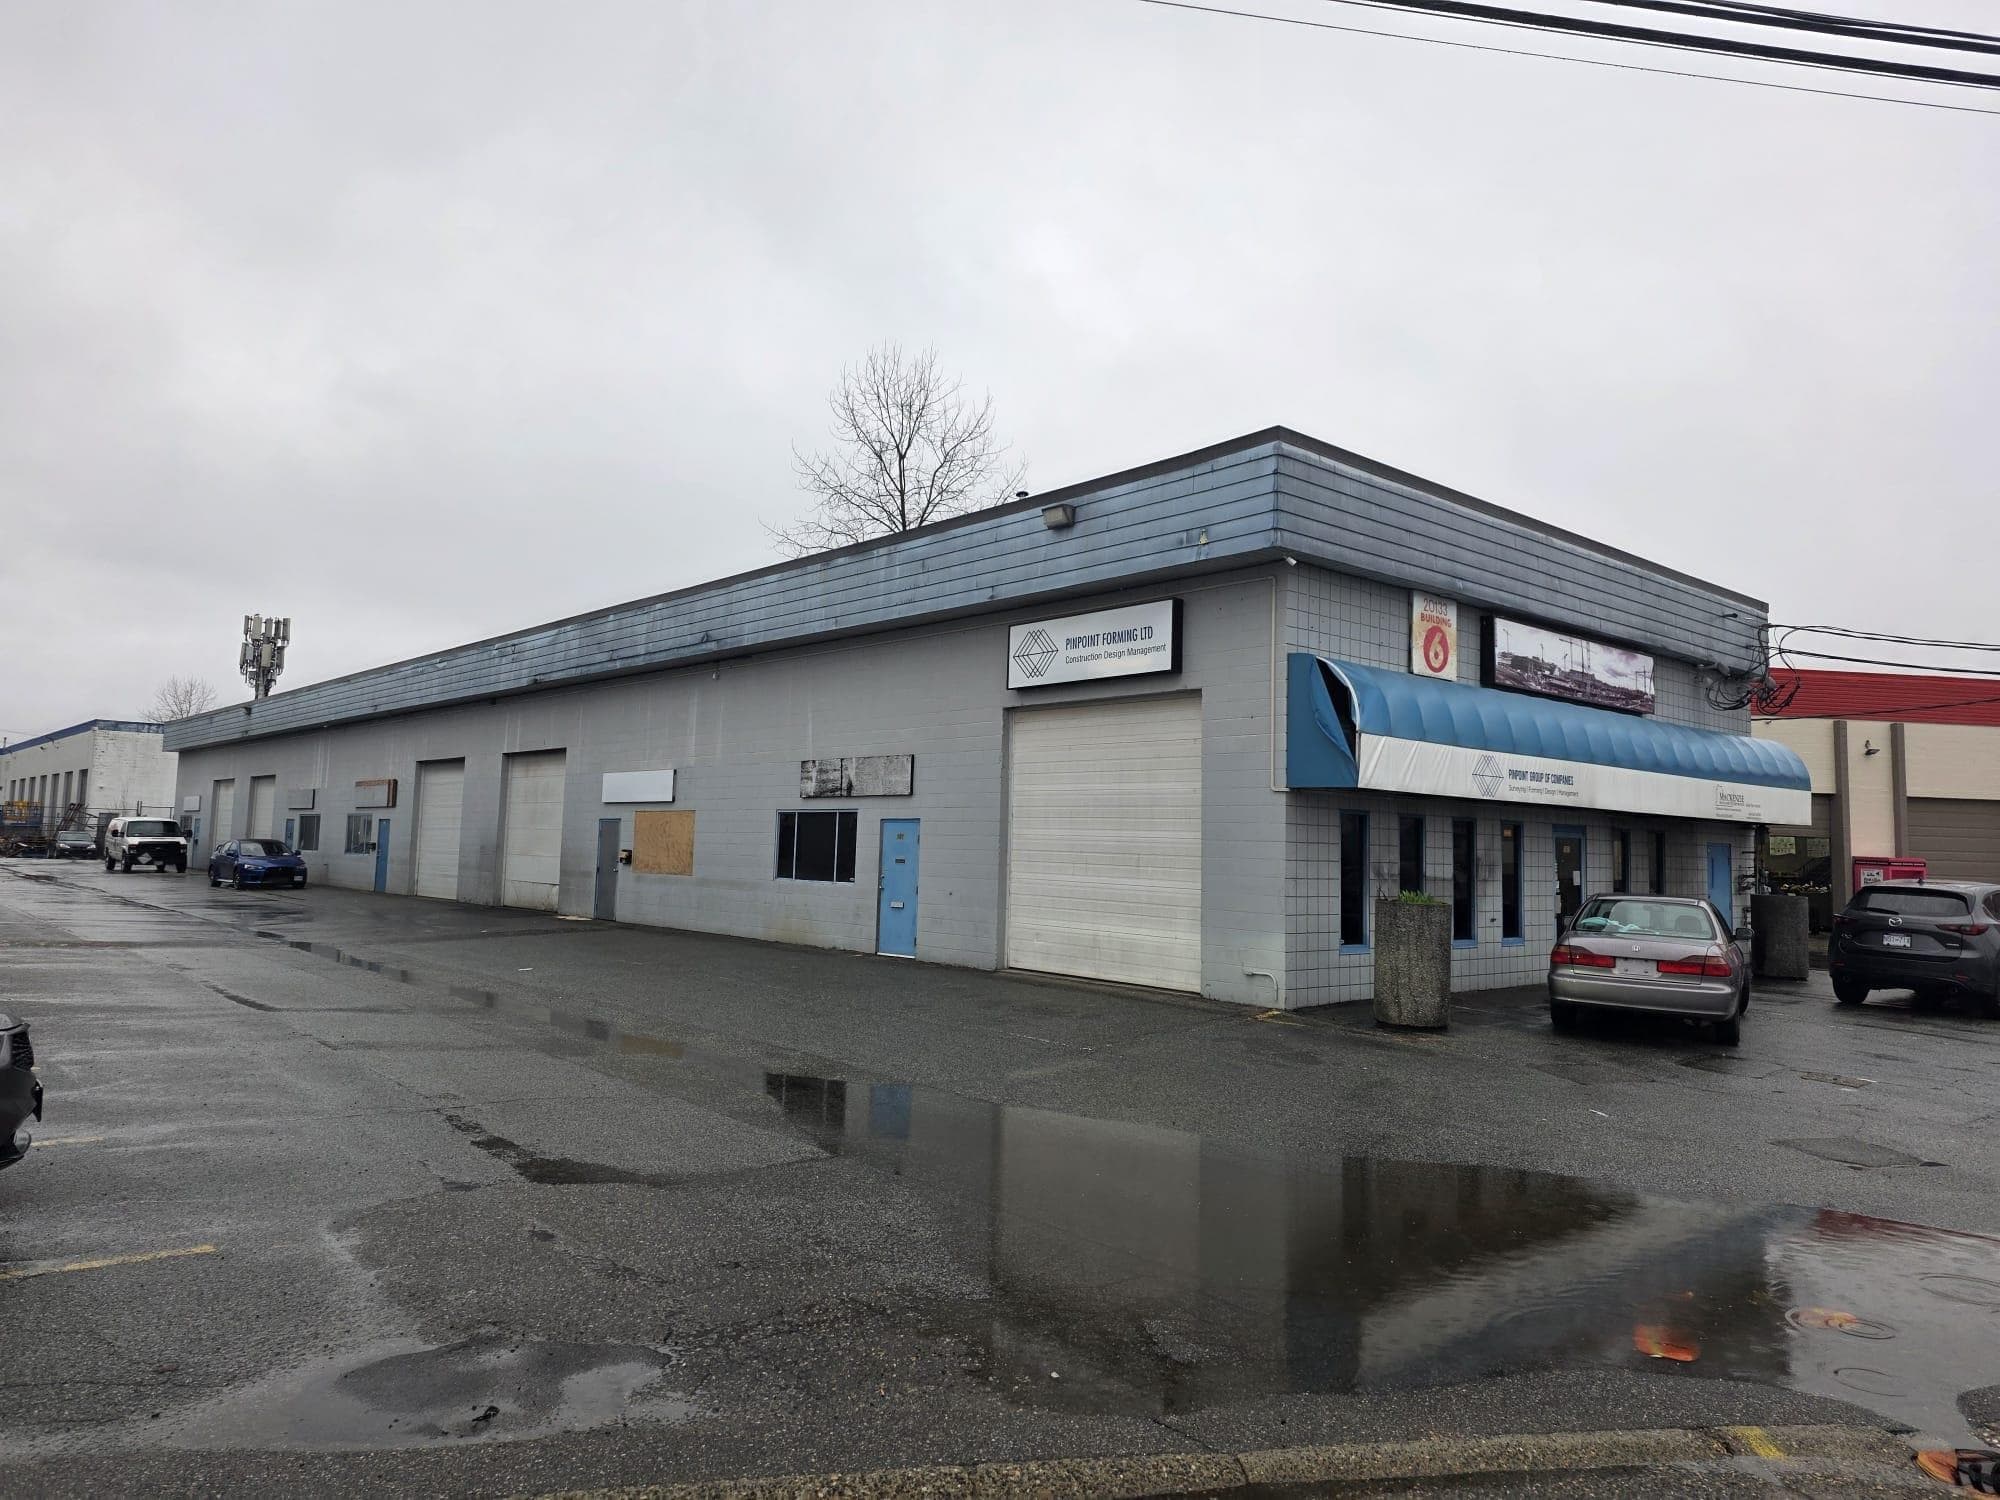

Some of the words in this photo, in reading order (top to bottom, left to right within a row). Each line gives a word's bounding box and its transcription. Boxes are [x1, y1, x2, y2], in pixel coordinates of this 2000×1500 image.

[1423, 598, 1448, 616] 20133
[1420, 612, 1452, 628] BUILDING
[1065, 633, 1101, 651] PINPOINT
[1102, 628, 1138, 646] FORMING
[1140, 625, 1154, 641] LTD
[1065, 652, 1103, 664] Construction
[1103, 650, 1126, 660] Design
[1127, 643, 1167, 656] Management
[1429, 632, 1444, 669] 6
[1508, 769, 1529, 781] PINPOINT
[1529, 771, 1544, 783] GROUP
[1544, 773, 1551, 783] OF
[1551, 774, 1574, 786] COMPANIES
